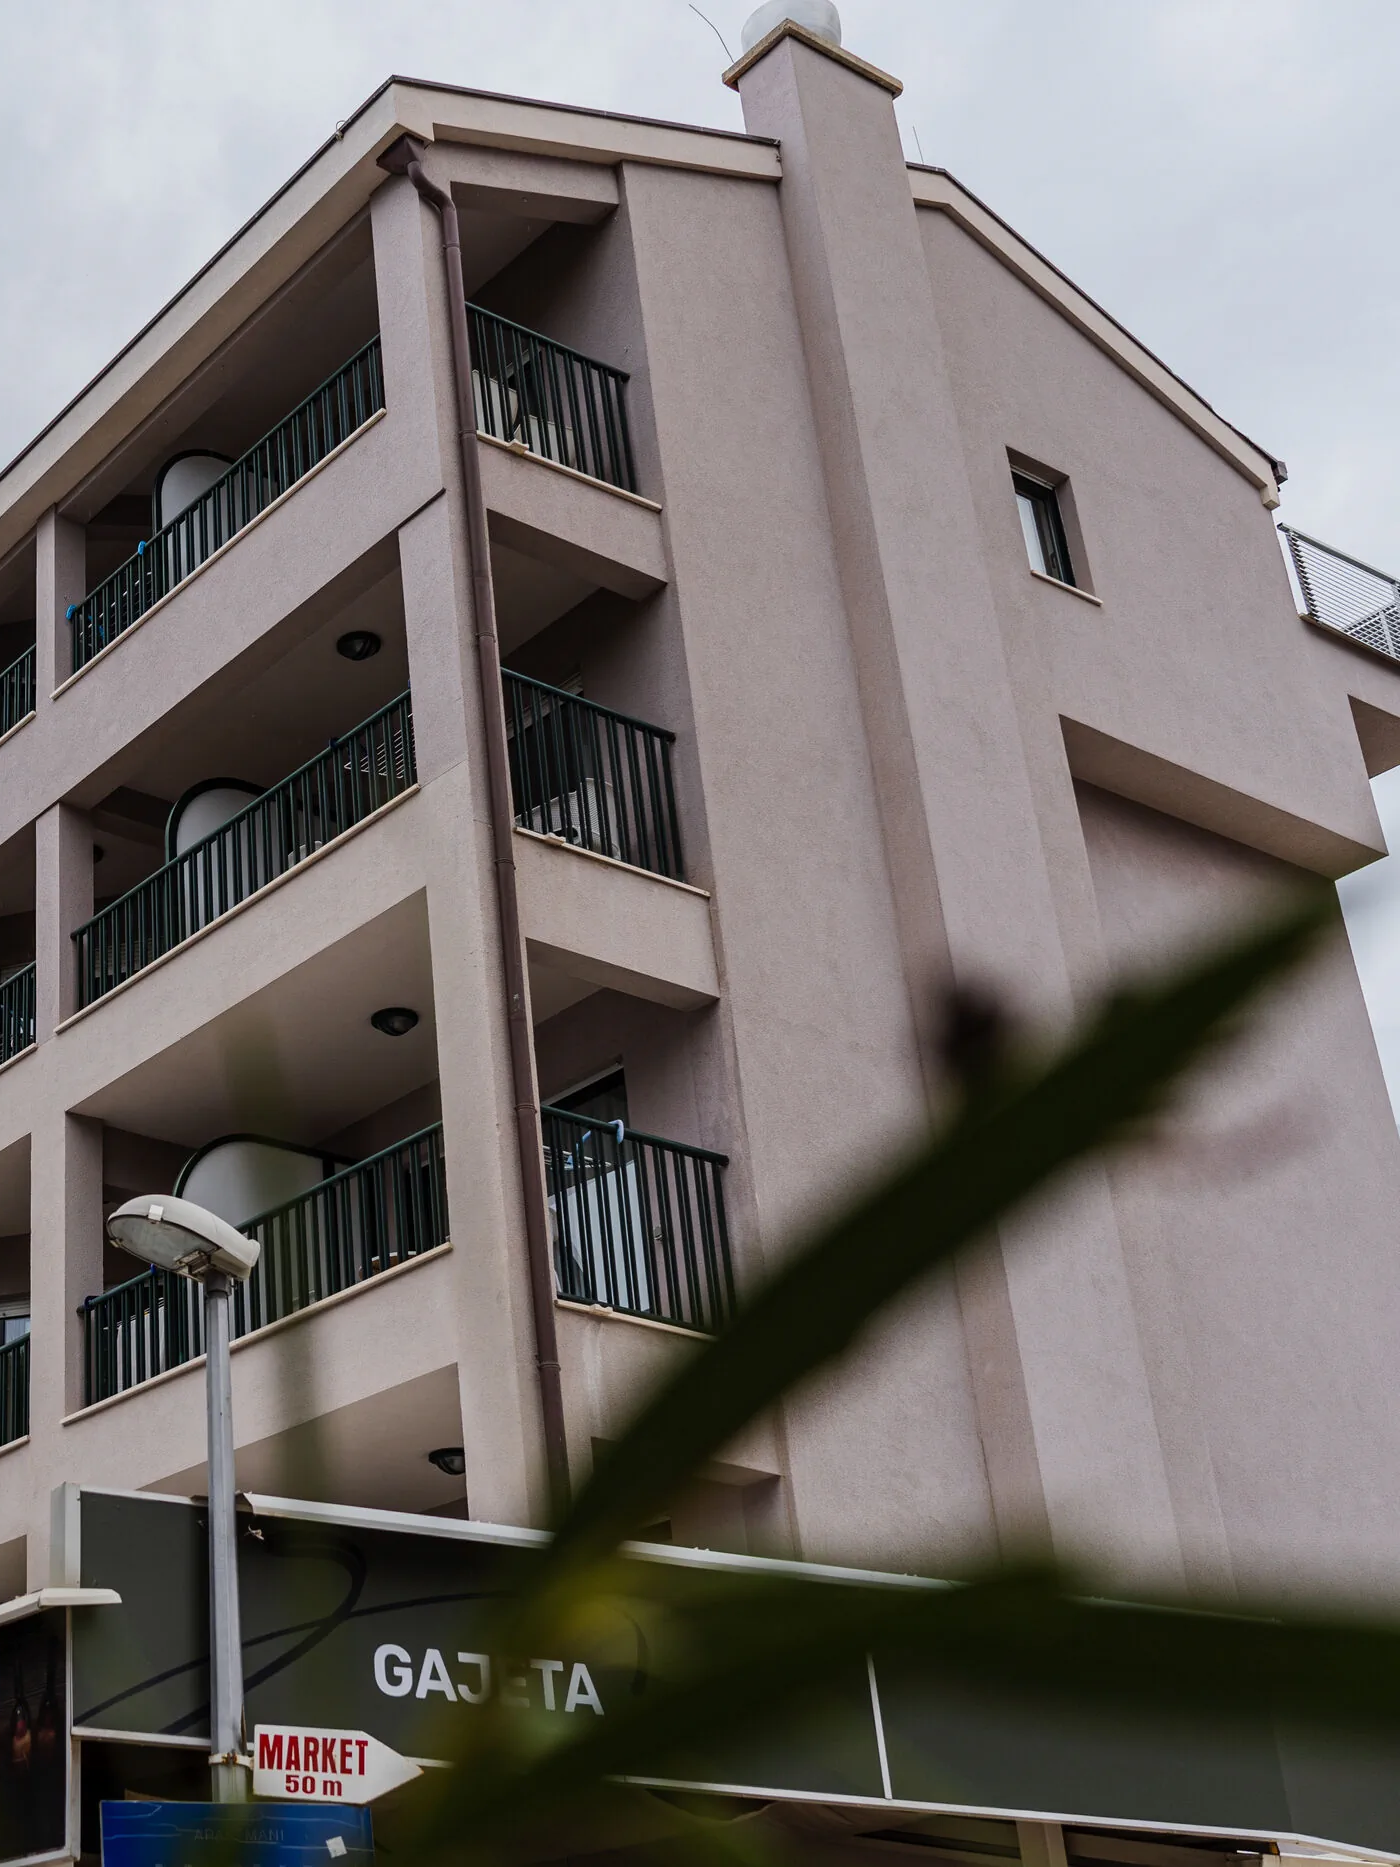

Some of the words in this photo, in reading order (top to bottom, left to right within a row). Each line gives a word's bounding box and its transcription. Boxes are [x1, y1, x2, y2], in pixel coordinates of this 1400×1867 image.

[259, 1734, 369, 1776] MARKET
[285, 1774, 316, 1795] 50
[322, 1780, 342, 1797] m
